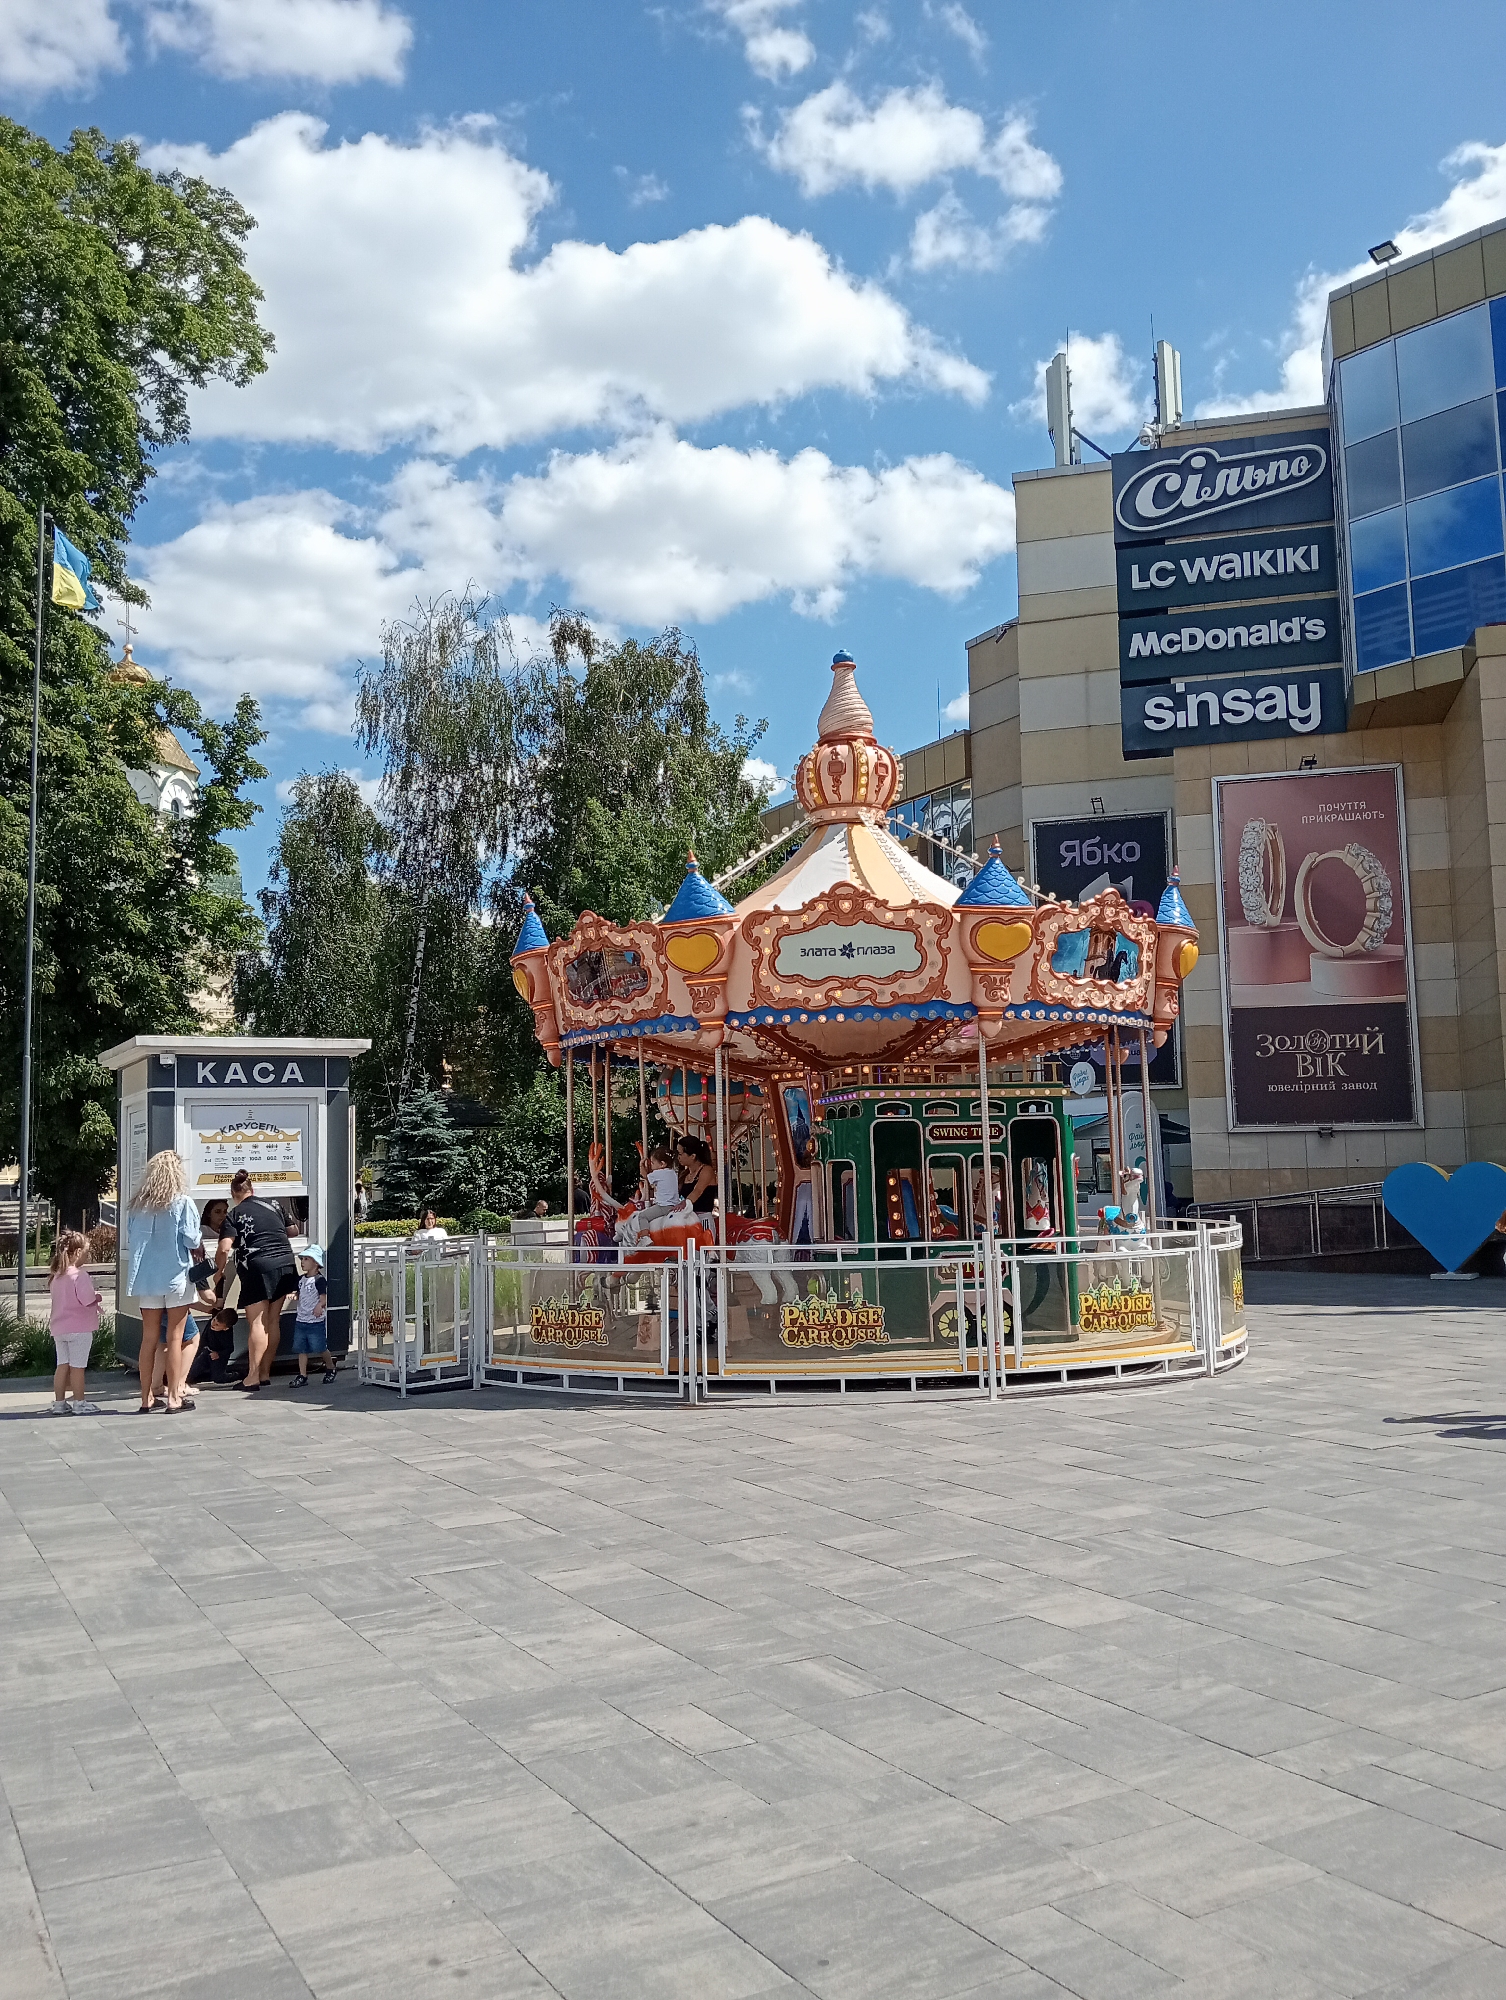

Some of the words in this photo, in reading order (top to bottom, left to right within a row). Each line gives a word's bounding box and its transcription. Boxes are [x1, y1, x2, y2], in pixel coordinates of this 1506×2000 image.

[1135, 456, 1312, 518] Сільпо
[1131, 561, 1176, 590] LC
[1129, 616, 1326, 658] McDonald's
[1144, 682, 1321, 733] sinsay
[1318, 801, 1366, 812] ПОЧУТТЯ
[1301, 811, 1385, 824] ПРИКРАШАЮТЬ
[1060, 836, 1140, 867] Ябко
[800, 947, 836, 957] злата
[857, 945, 895, 955] плаза
[1255, 1026, 1386, 1057] ЗОЛОТИЙ
[197, 1062, 304, 1083] КАСА
[1295, 1052, 1350, 1077] ВІК
[1268, 1081, 1336, 1094] ювелірний
[1341, 1082, 1378, 1091] завод
[220, 1121, 280, 1135] КАРУСЕЛЬ
[933, 1127, 968, 1137] SWING
[971, 1127, 999, 1136] TIE
[1079, 1294, 1153, 1315] PARADISE
[531, 1306, 603, 1327] PARADISE
[783, 1306, 883, 1326] PARADISE
[1080, 1312, 1156, 1332] CARROUSEL
[531, 1326, 607, 1347] CARROUSEL
[782, 1327, 889, 1347] CARROUSEL
